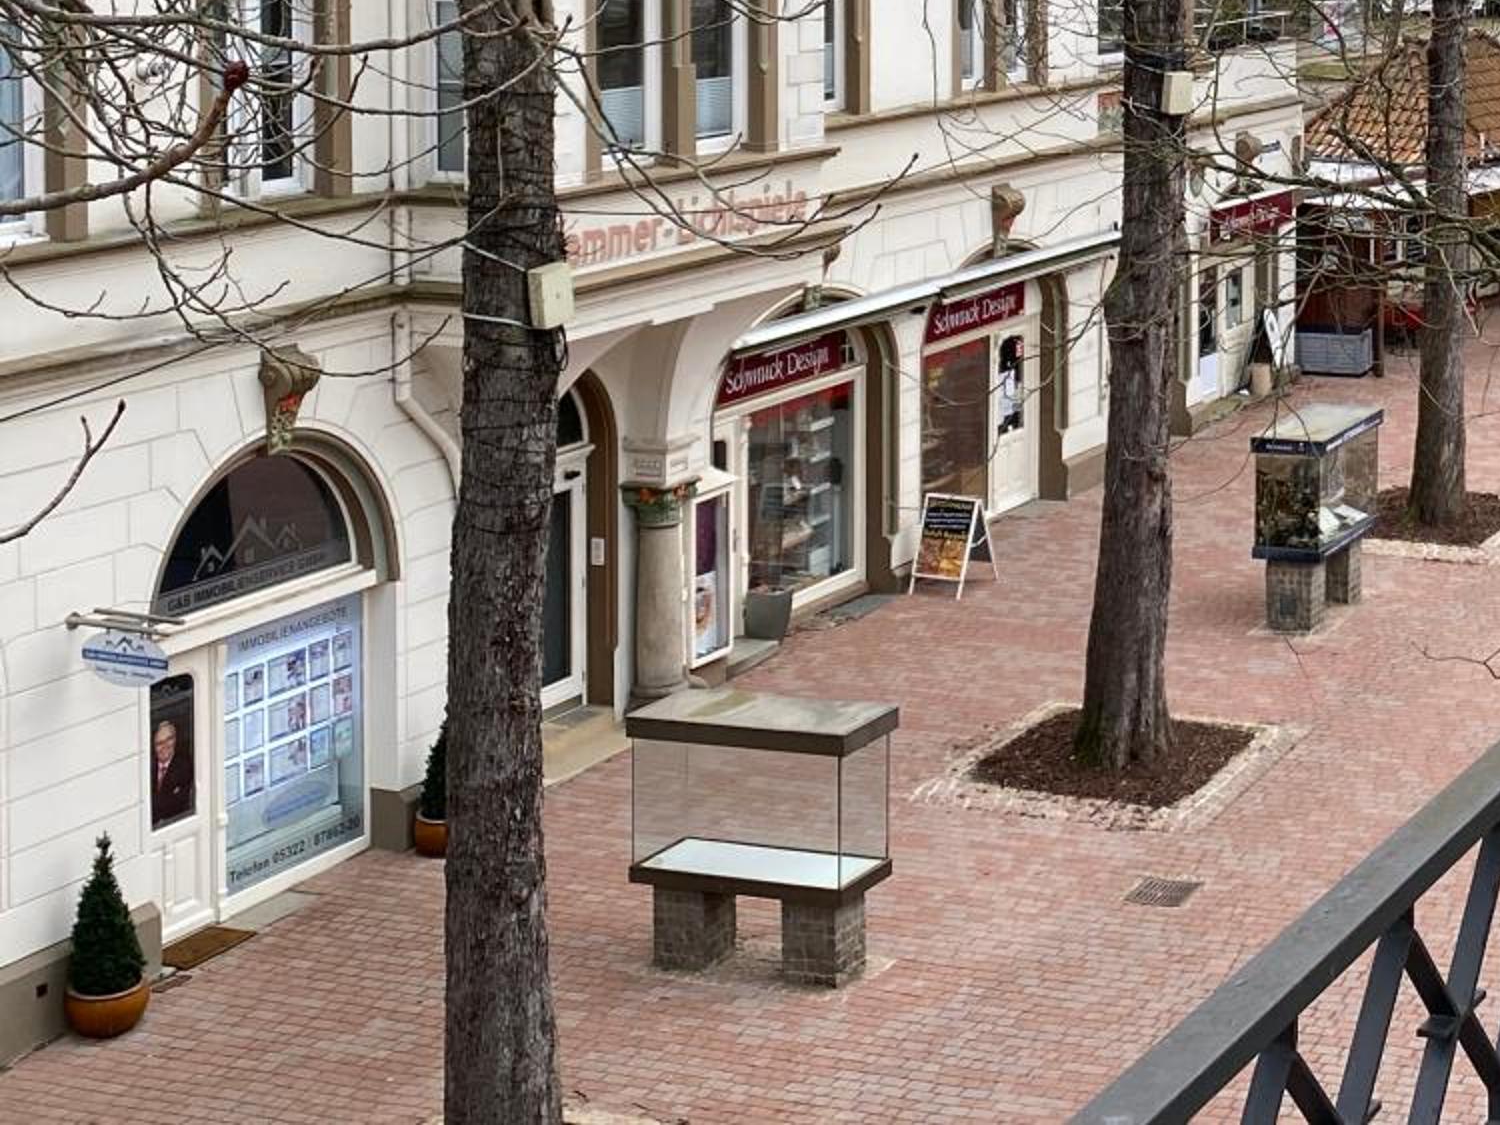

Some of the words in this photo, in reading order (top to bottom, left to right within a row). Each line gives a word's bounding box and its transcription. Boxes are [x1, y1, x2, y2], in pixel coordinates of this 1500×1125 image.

[933, 297, 980, 335] Schmuck
[982, 291, 1016, 320] Design
[725, 353, 784, 394] Schmuck
[787, 344, 830, 376] Design
[230, 858, 270, 883] Telefon
[272, 839, 305, 864] 05322
